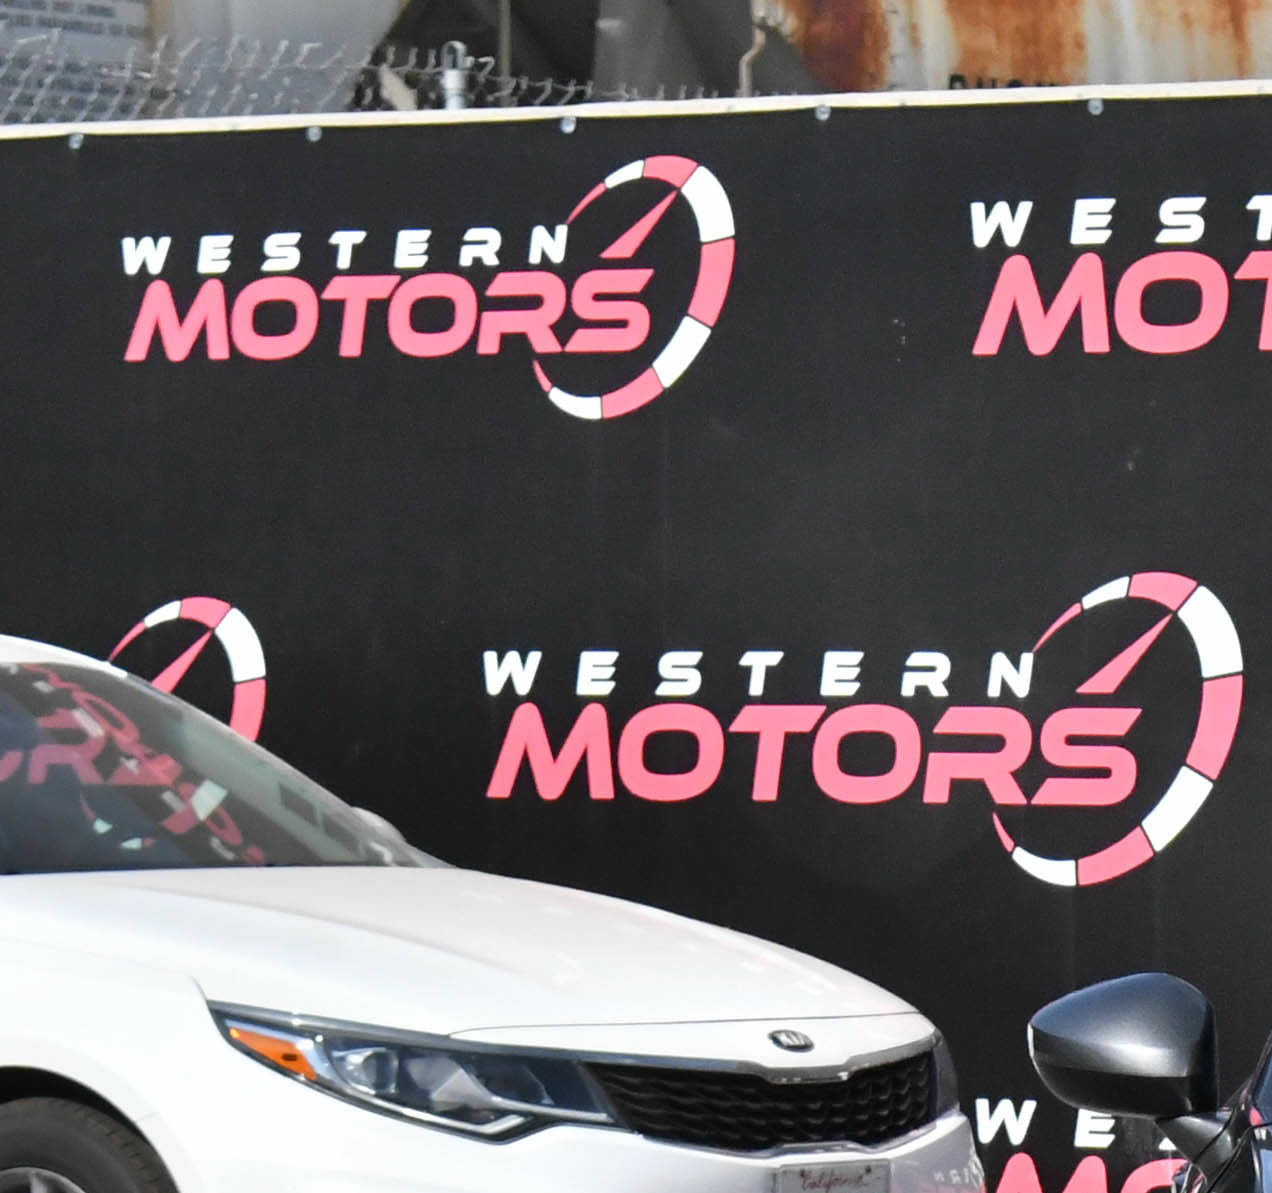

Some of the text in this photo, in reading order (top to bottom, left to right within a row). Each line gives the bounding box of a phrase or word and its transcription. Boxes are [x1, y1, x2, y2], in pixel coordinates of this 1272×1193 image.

[121, 224, 569, 275] WESTERN
[124, 268, 655, 363] MOTORS
[483, 650, 1034, 699] WESTERN
[486, 701, 1143, 807] MOTORS
